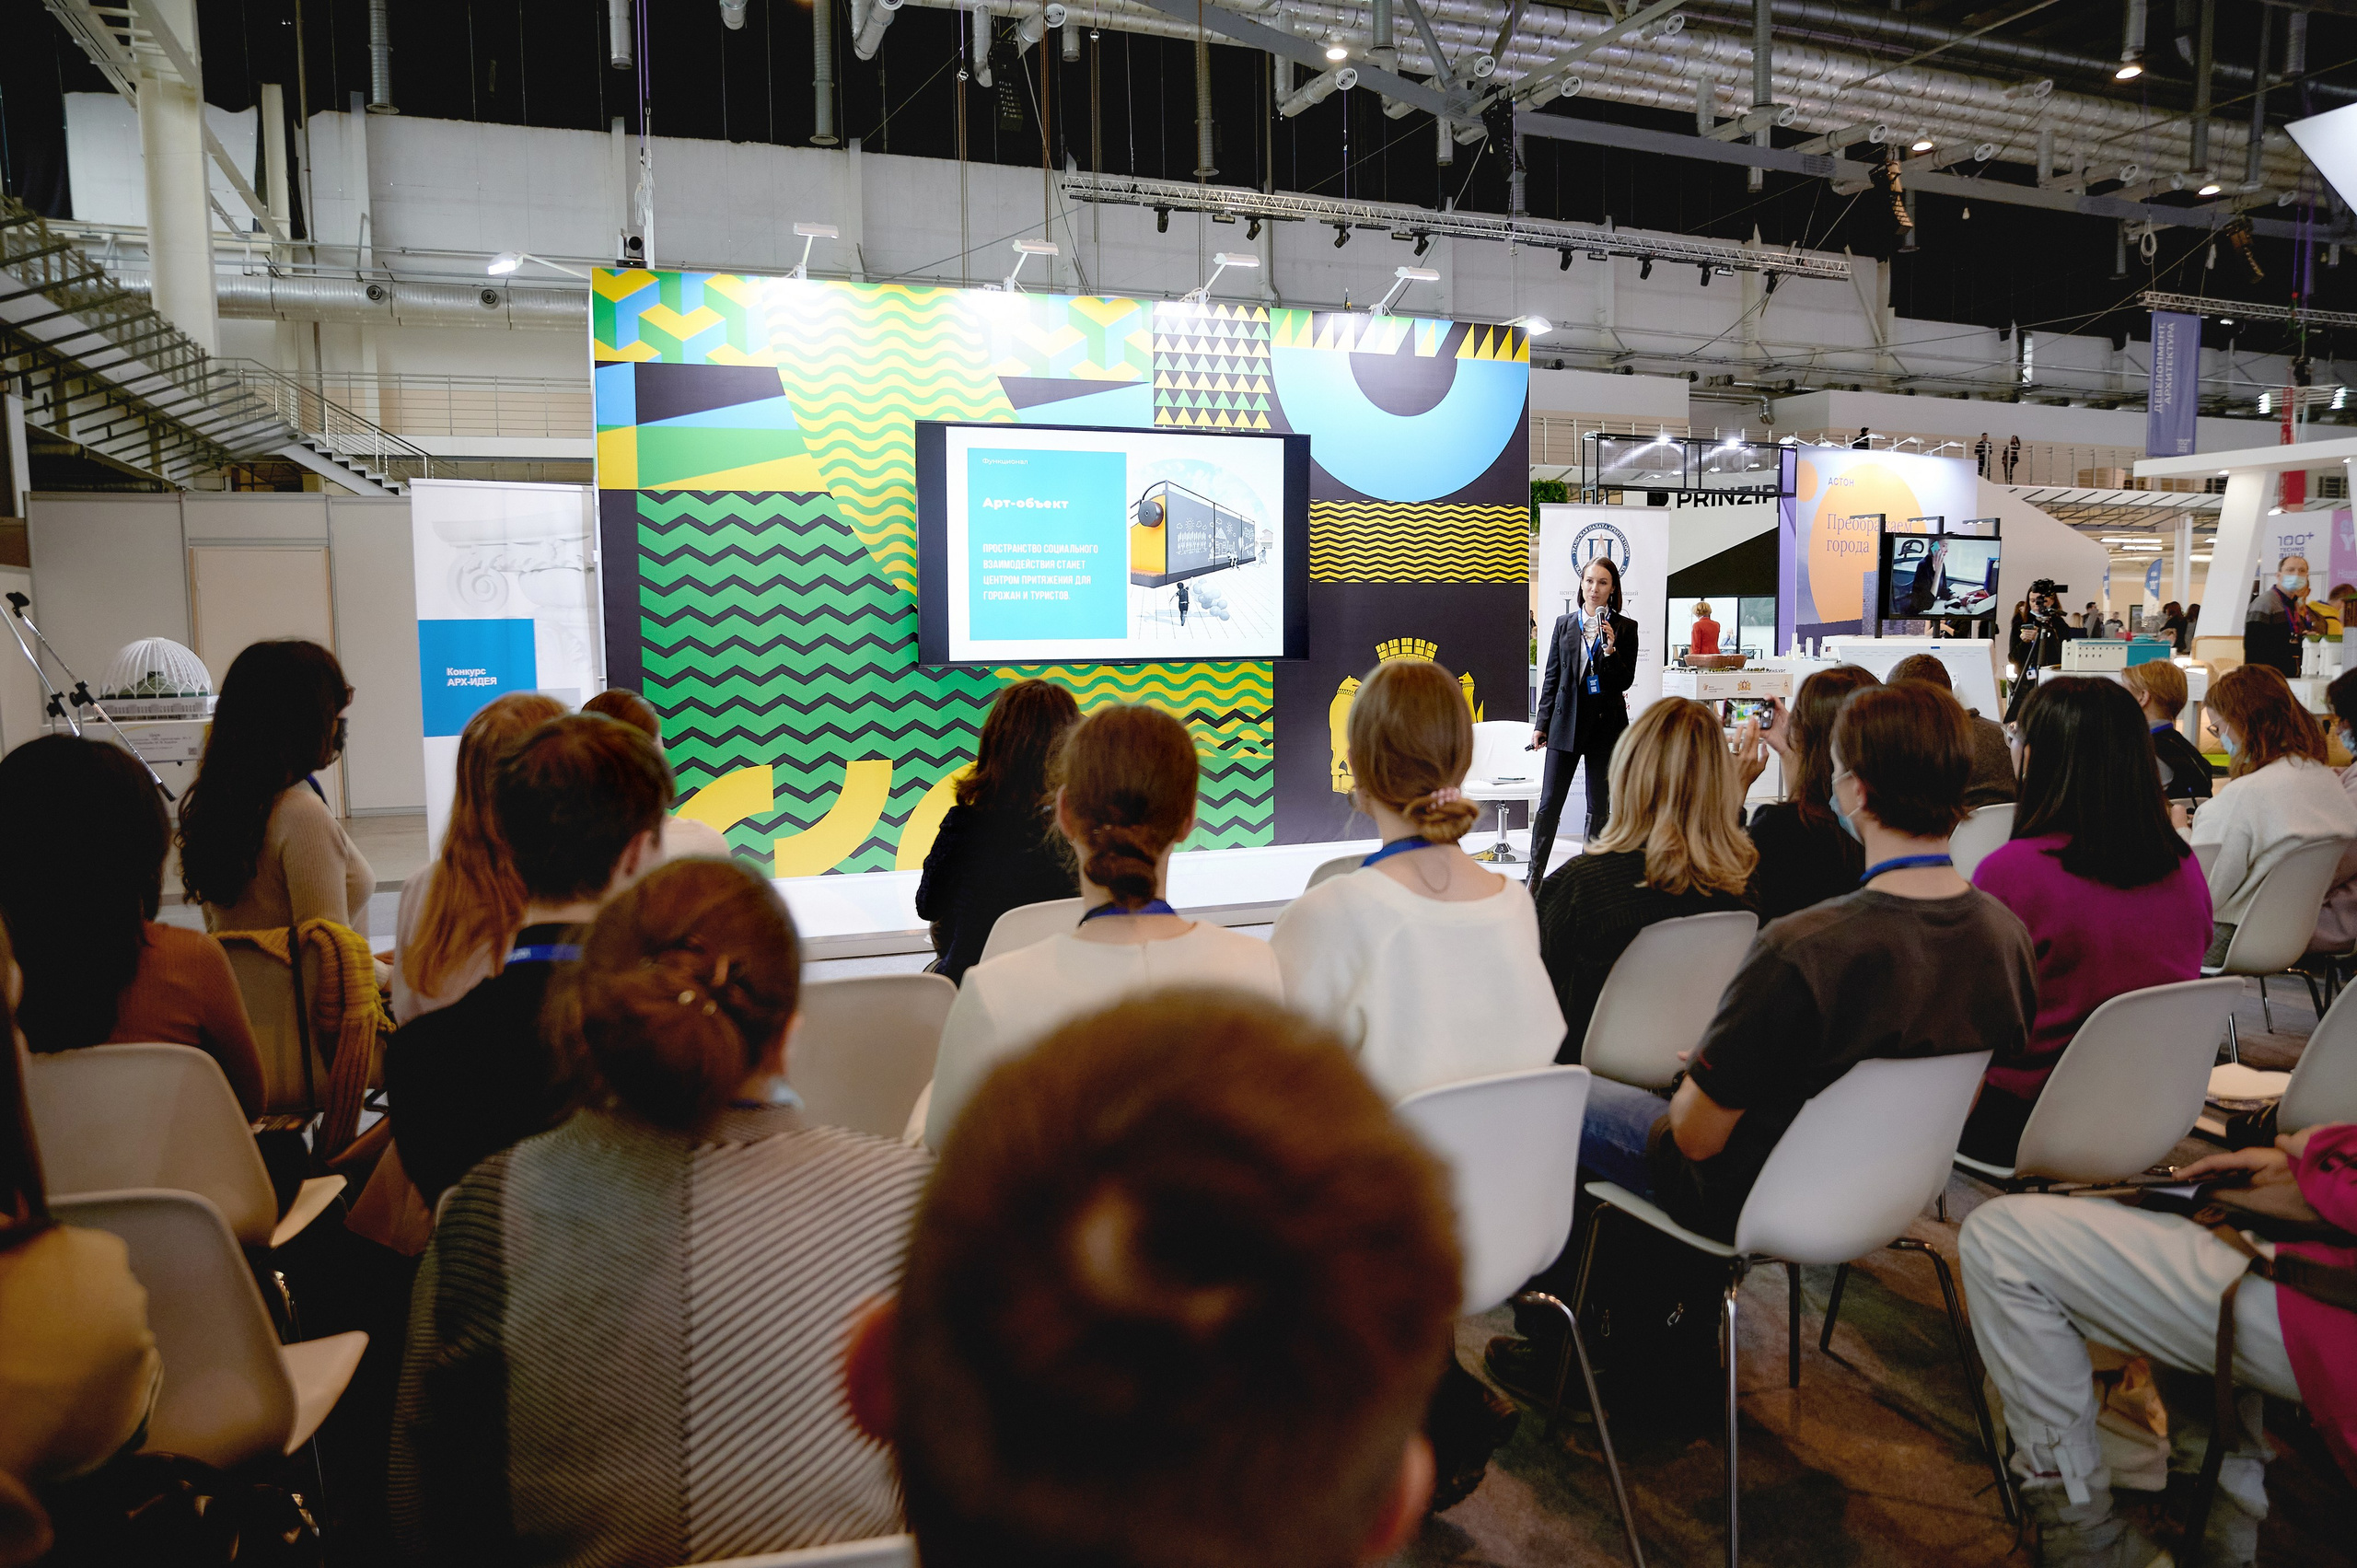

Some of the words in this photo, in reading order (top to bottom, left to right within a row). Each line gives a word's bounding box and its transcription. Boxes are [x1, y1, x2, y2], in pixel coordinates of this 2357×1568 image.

[2164, 322, 2176, 406] АРХИТЕКТУРА
[1828, 477, 1854, 487] АСТОН
[1677, 484, 1779, 508] PRINZIP
[982, 497, 1069, 510] Арт-объект
[982, 543, 1042, 553] ПРОСТРАНСТВО
[1043, 544, 1098, 554] СОЦИАЛЬНОГО
[1826, 540, 1870, 557] города
[982, 559, 1055, 570] ВЗАИМОДЕЙСТВИЯ
[1056, 560, 1086, 569] СТАНЕТ
[982, 575, 1019, 585] ЦЕНТРОМ
[1021, 575, 1074, 585] ПРИТЯЖЕНИЯ
[1074, 575, 1092, 586] ДЛЯ
[983, 591, 1021, 600] ГОРОЖАН
[1022, 591, 1028, 600] И
[1030, 591, 1071, 600] ТУРИСТОВ.
[447, 668, 486, 678] Конкурс
[447, 677, 497, 688] АРХ-ИДЕЯ
